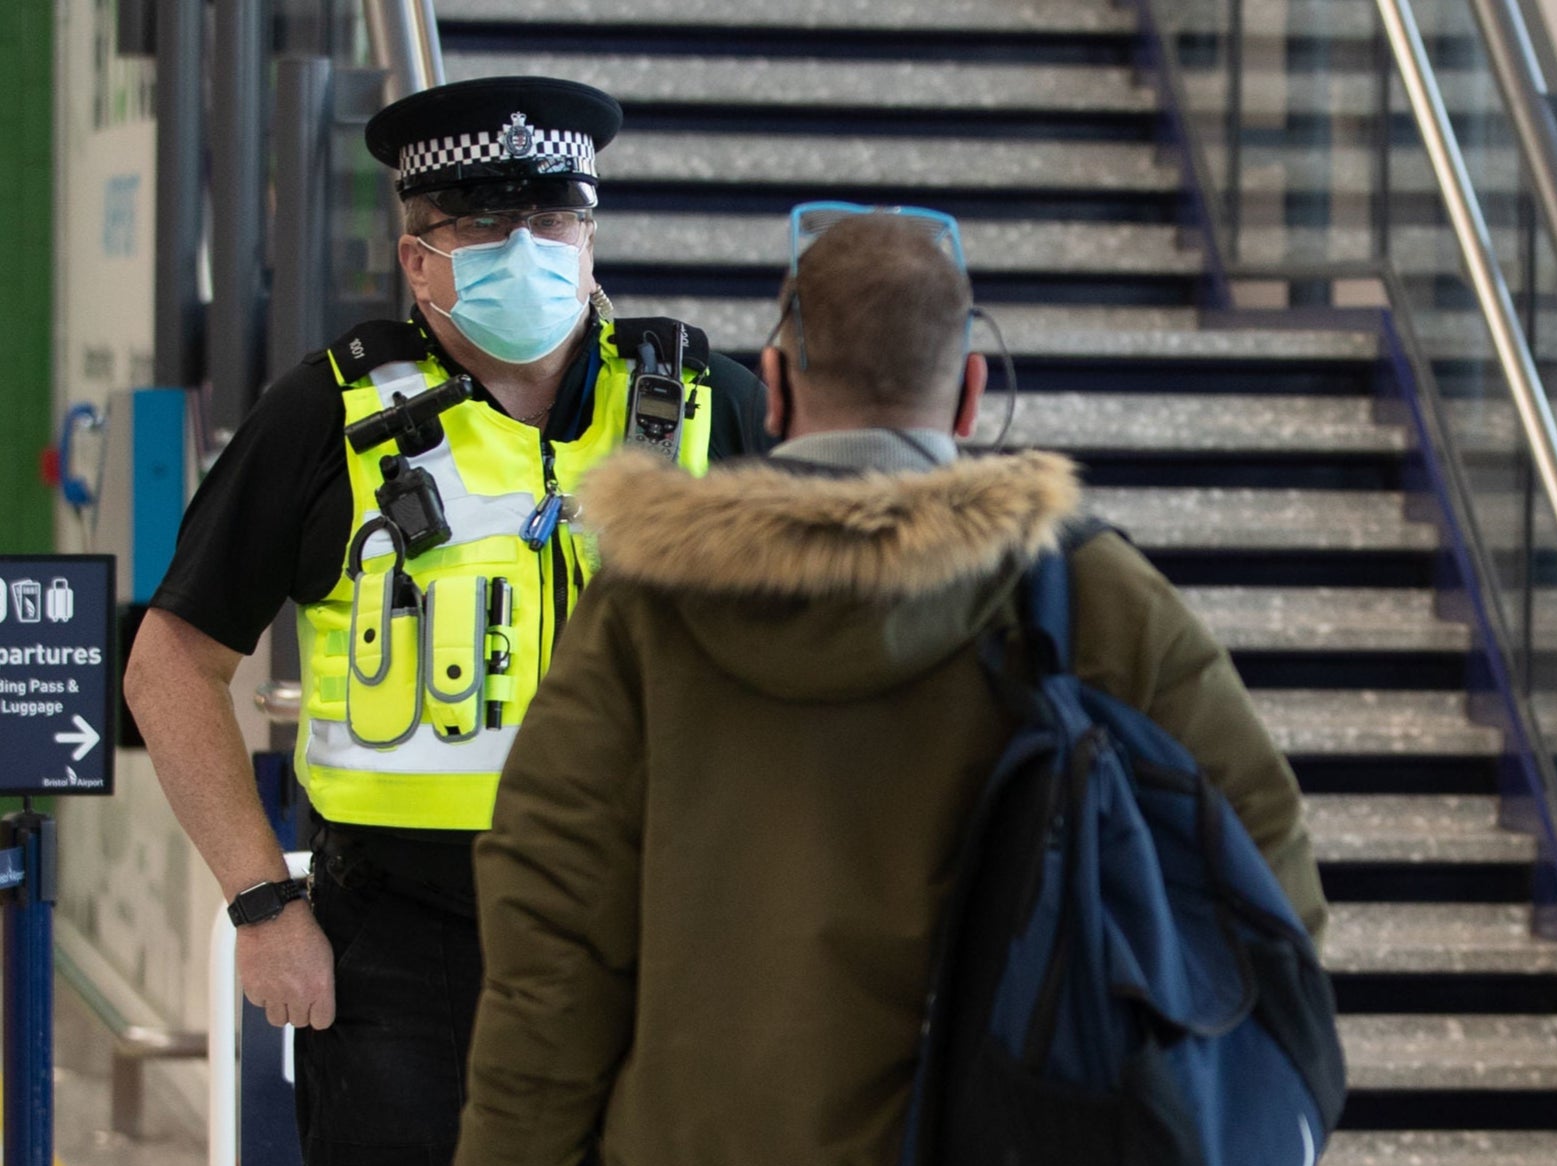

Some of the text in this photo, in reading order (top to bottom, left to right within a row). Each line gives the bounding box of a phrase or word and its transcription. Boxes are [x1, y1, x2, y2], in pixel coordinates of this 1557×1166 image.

[30, 679, 65, 693] Pass
[68, 679, 80, 693] &
[2, 699, 64, 716] Luggage
[43, 778, 104, 788] Bristol Airport
